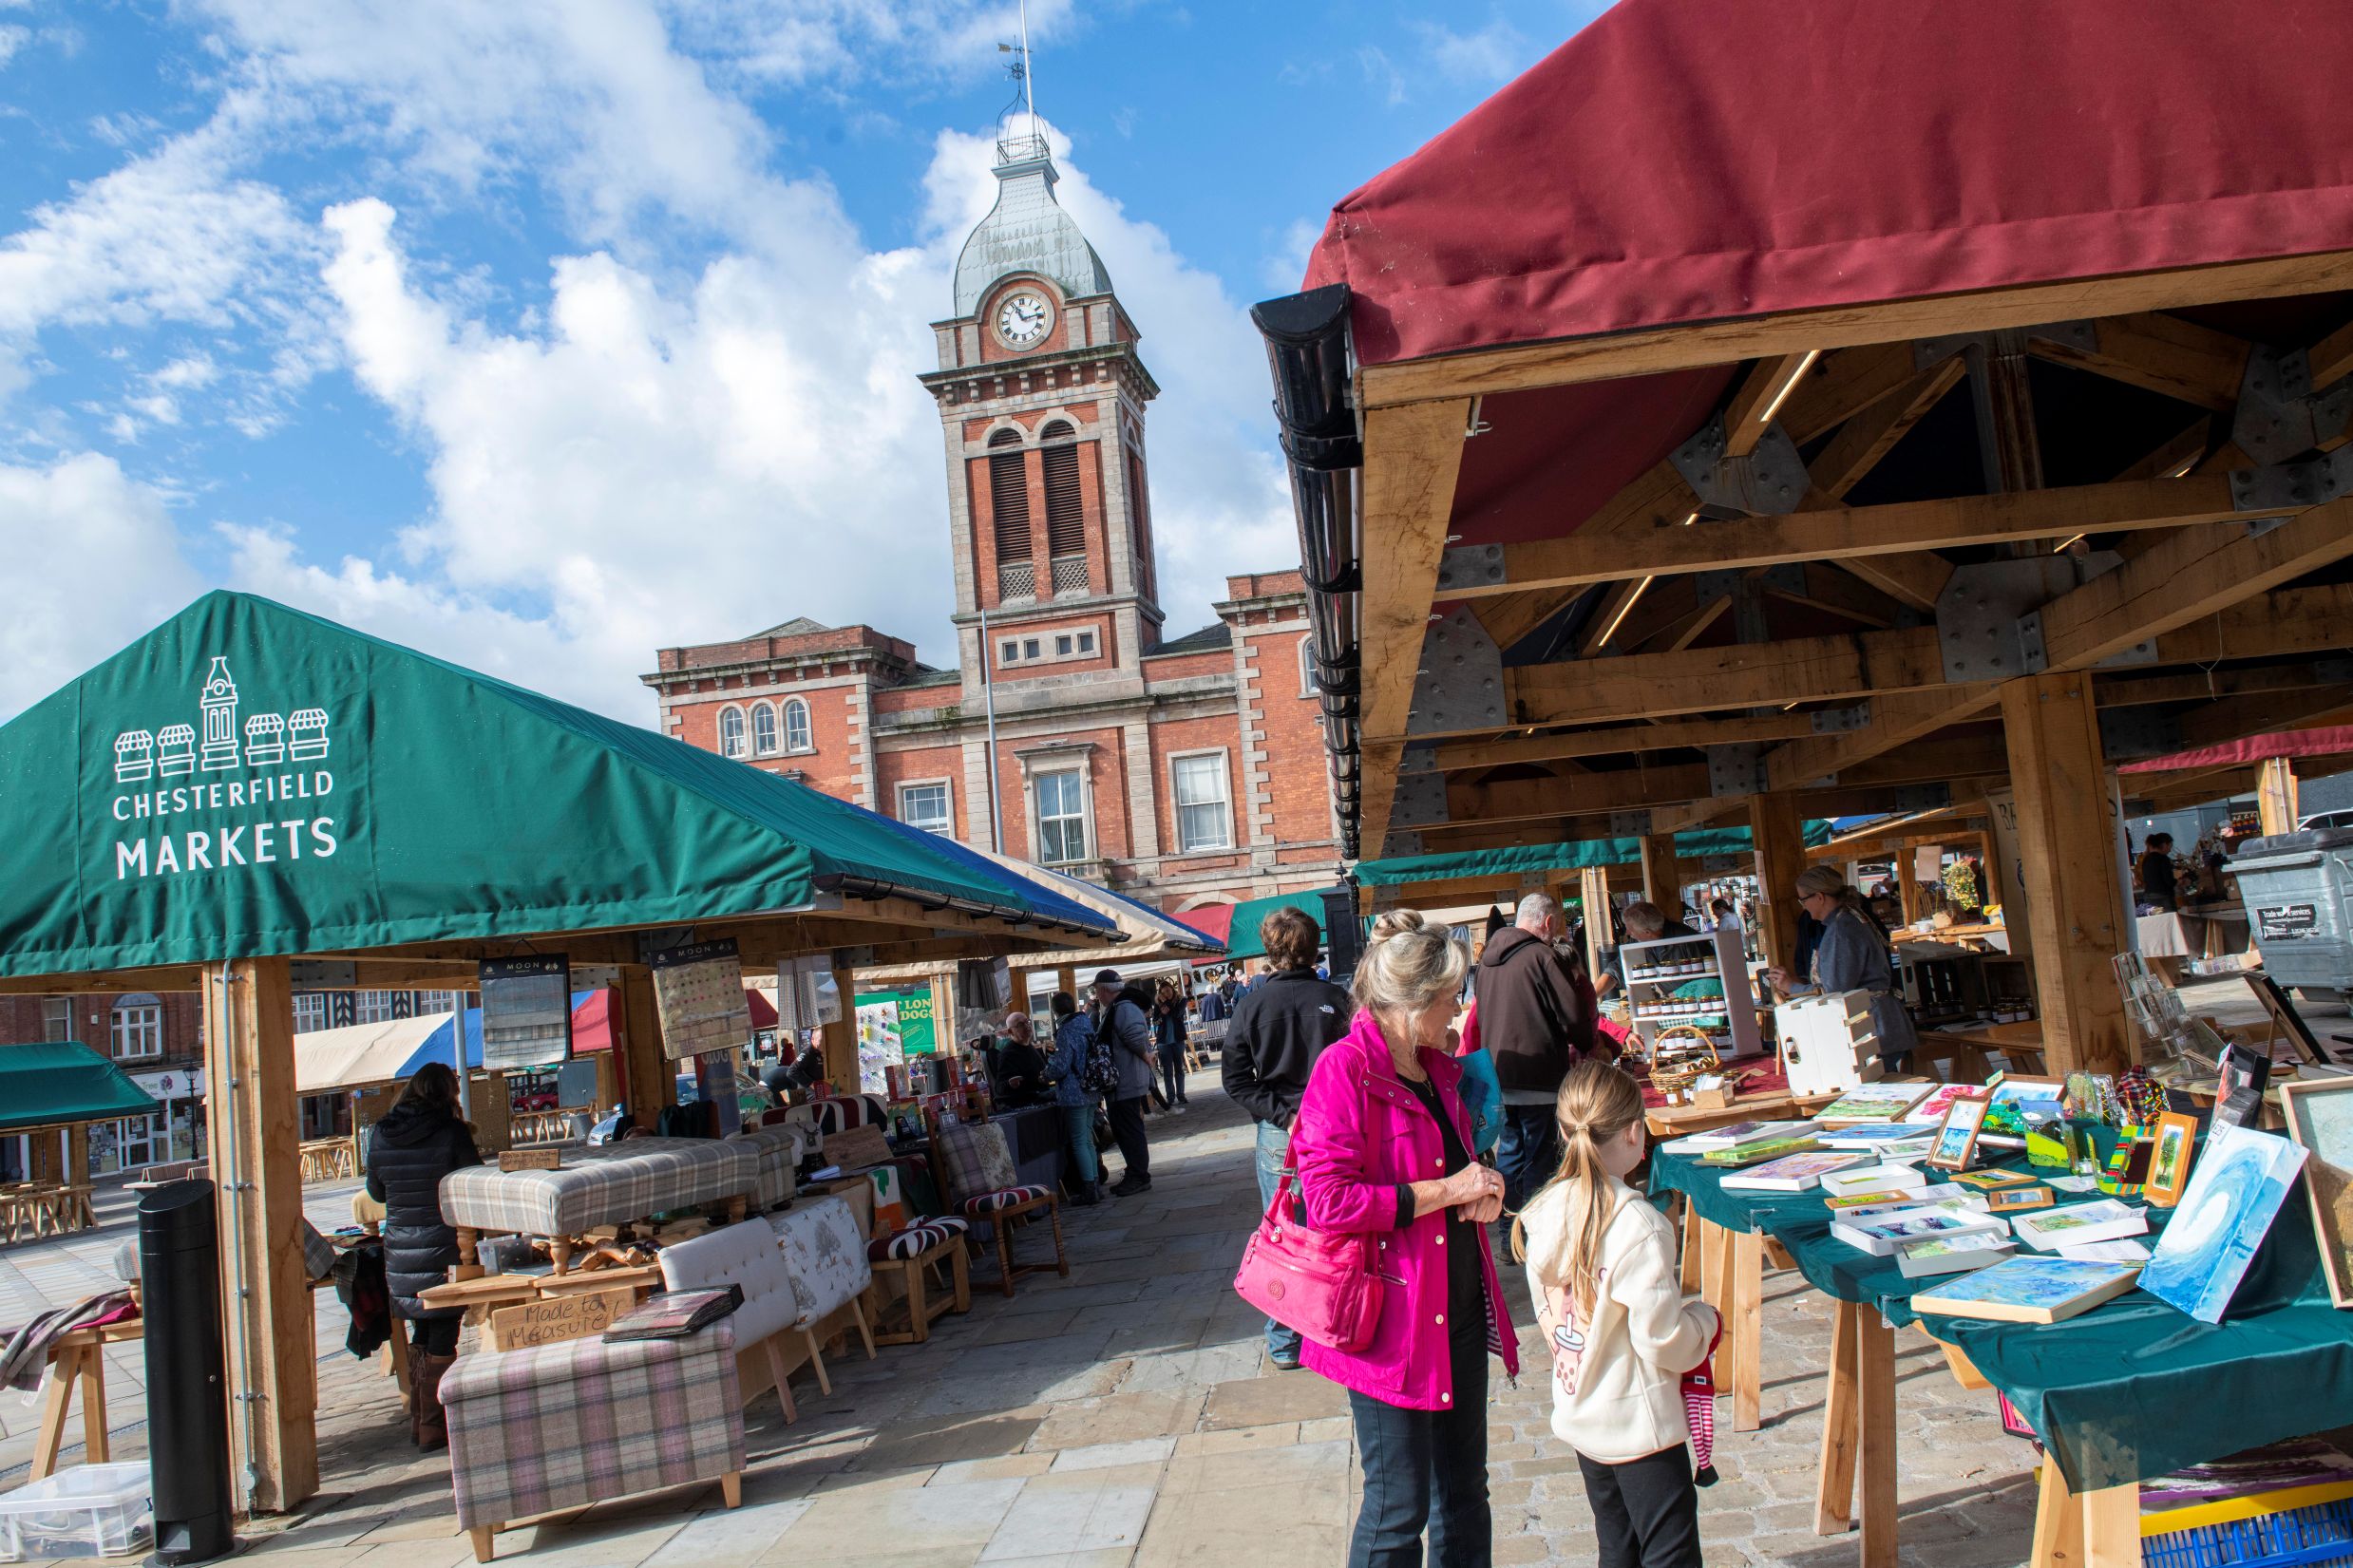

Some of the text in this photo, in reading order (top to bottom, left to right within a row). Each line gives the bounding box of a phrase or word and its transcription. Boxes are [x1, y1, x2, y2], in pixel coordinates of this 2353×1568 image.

[113, 770, 333, 821] CHESTERFIELD
[116, 817, 337, 879] MARKETS
[677, 945, 711, 957] MOON
[506, 961, 540, 971] MOON
[904, 998, 933, 1010] LON
[525, 1295, 602, 1323] Made to
